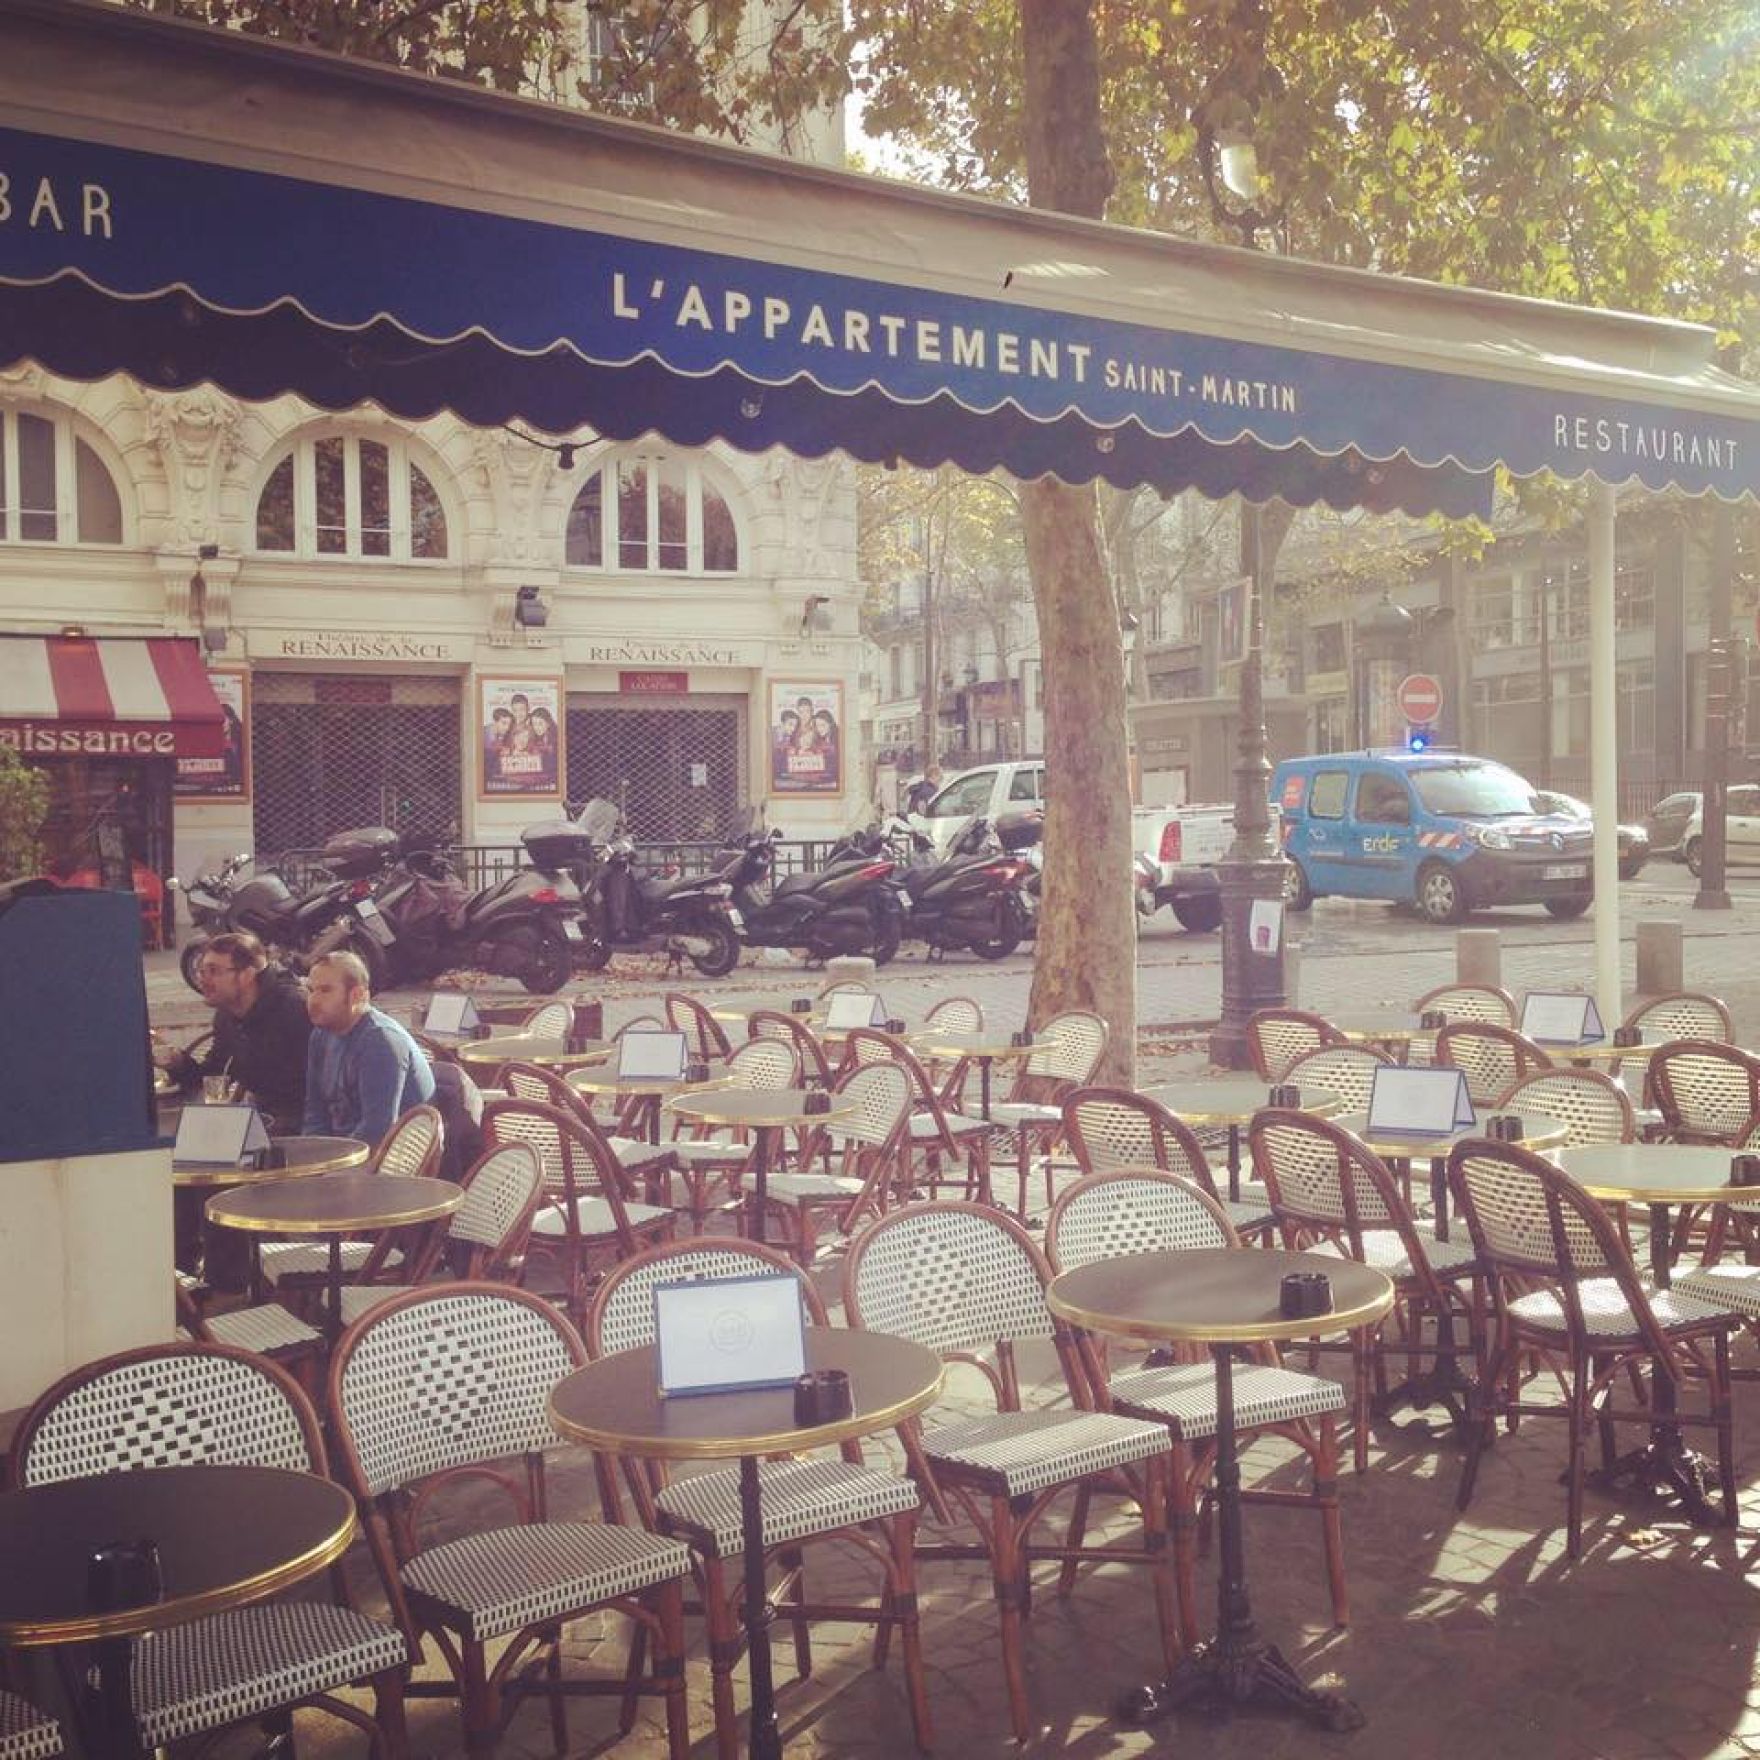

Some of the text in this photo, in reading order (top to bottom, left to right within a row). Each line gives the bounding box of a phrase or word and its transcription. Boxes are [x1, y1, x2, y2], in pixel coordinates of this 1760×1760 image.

[613, 272, 1092, 383] L'APPARTEMENT
[1554, 414, 1738, 470] RESTAURANT
[281, 640, 450, 658] RENAISSANCE
[589, 647, 740, 664] RENAISSANCE
